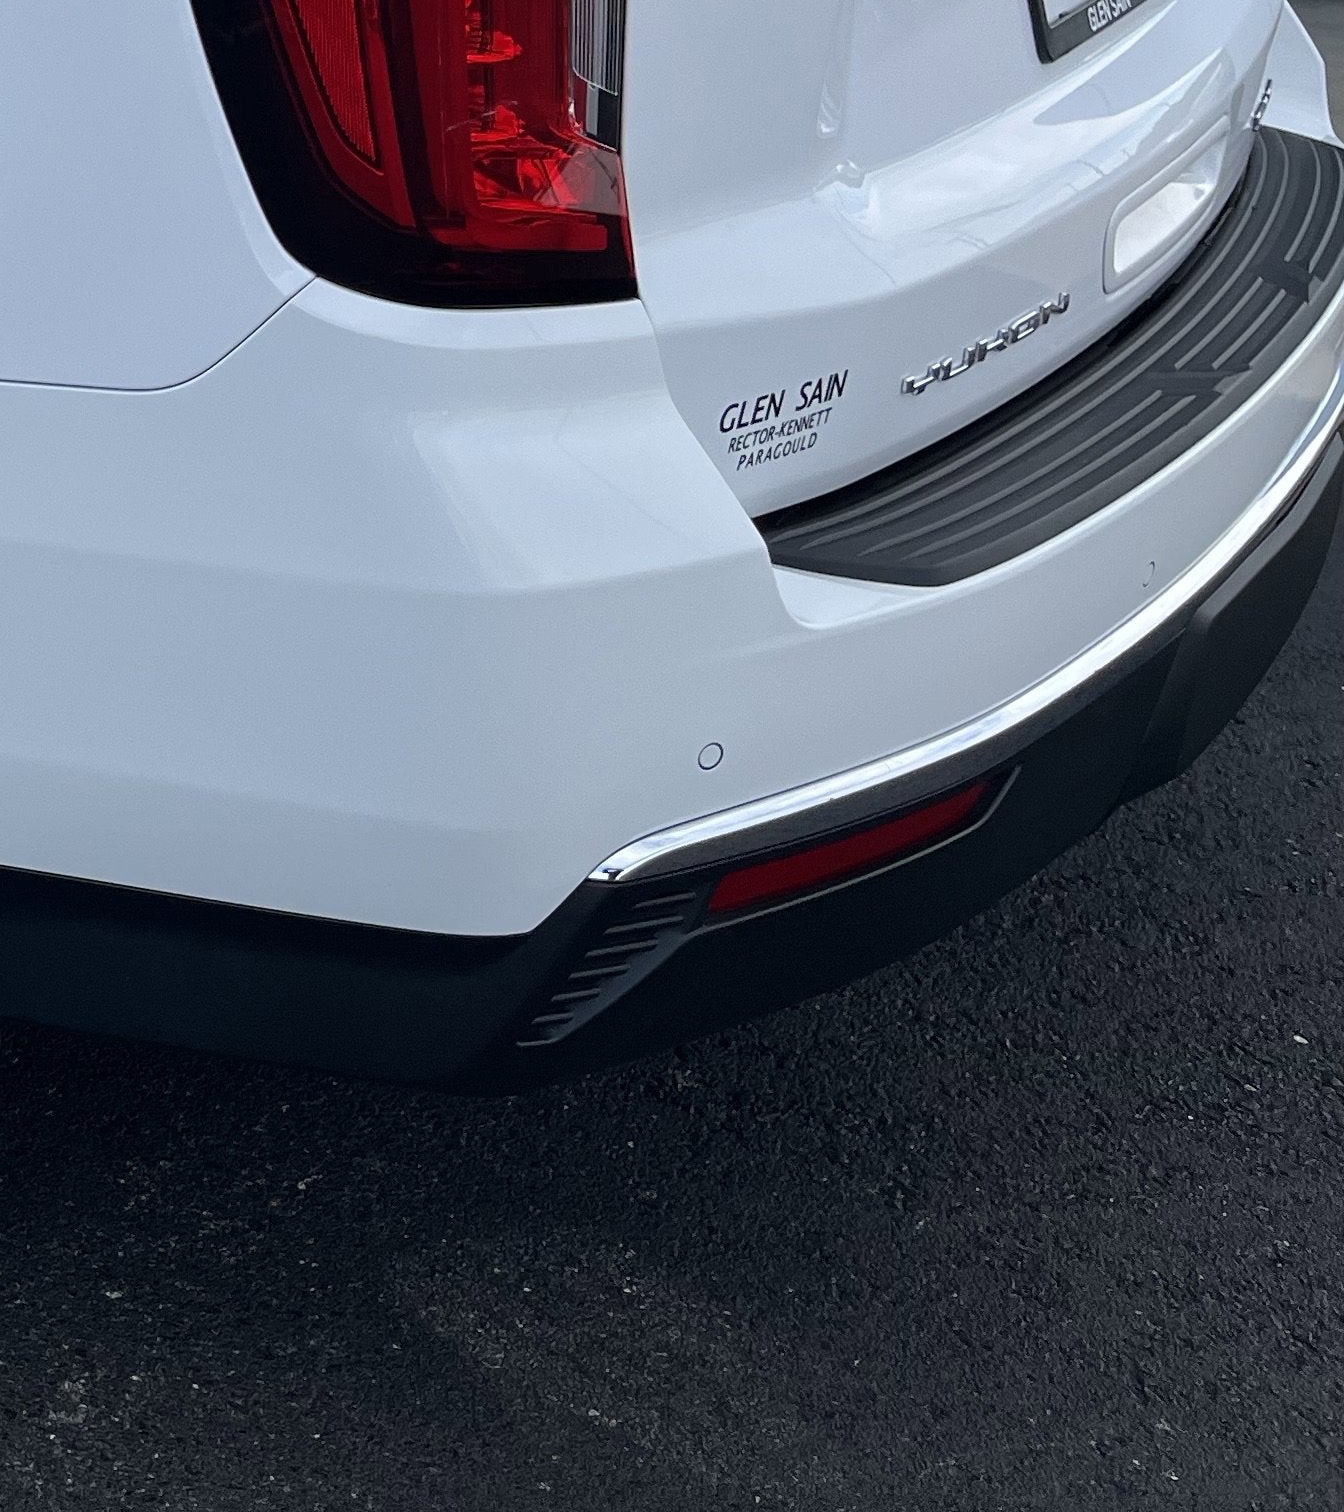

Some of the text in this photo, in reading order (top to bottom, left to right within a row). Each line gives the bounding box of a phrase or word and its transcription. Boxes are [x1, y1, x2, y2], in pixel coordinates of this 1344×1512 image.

[900, 291, 1071, 396] YUKON
[719, 369, 849, 434] GLEN SAIN
[727, 406, 833, 454] RECTOR-KENNETT
[736, 432, 818, 471] PARAGOULD
